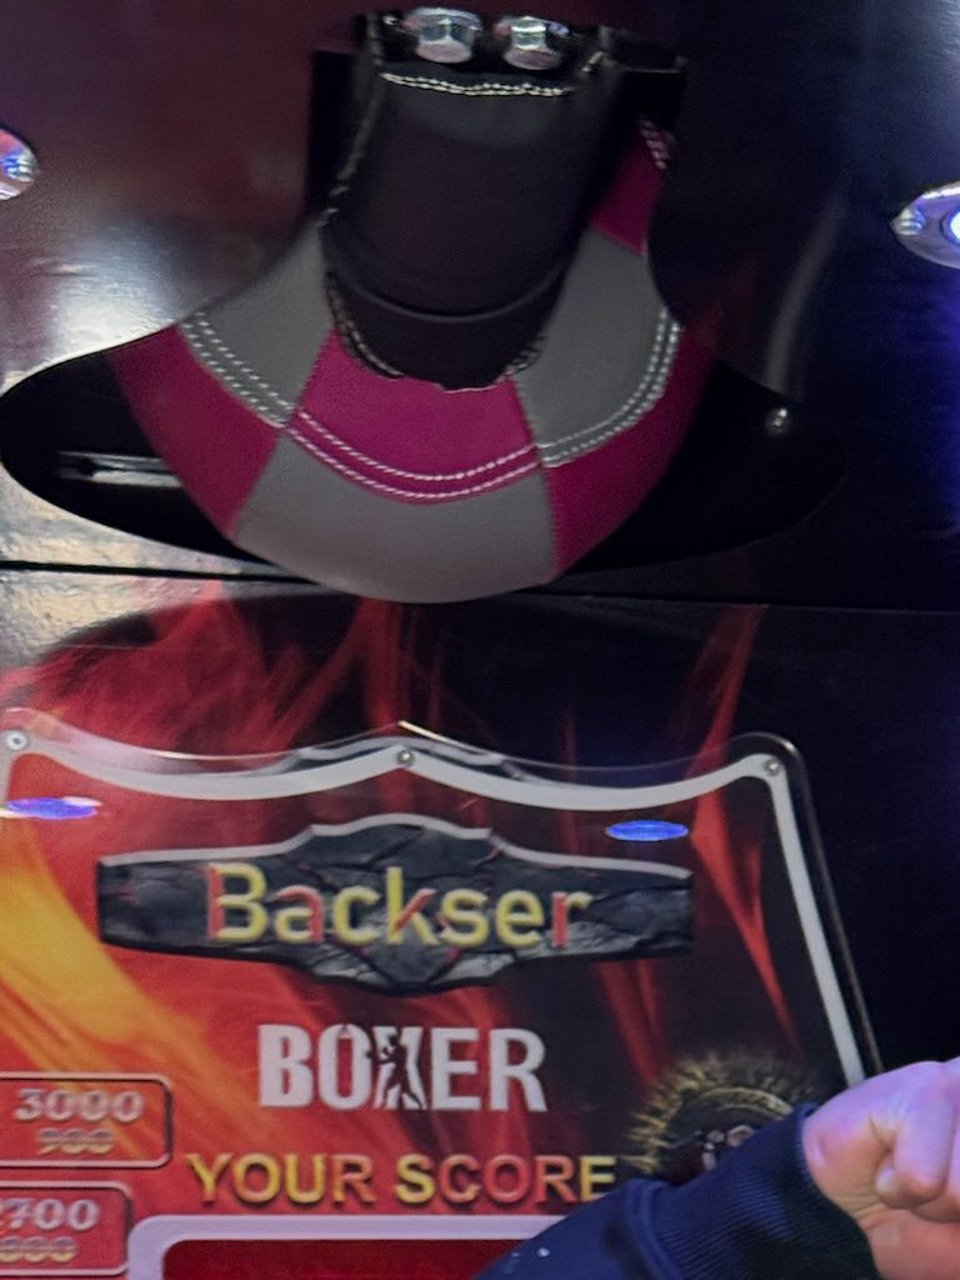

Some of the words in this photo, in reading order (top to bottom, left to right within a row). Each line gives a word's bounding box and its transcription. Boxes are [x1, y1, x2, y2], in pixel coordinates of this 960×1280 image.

[207, 862, 594, 949] Backser
[257, 1023, 548, 1112] BOXER
[13, 1088, 143, 1123] 3000
[186, 1153, 376, 1204] YOUR
[394, 1154, 618, 1204] SCORE
